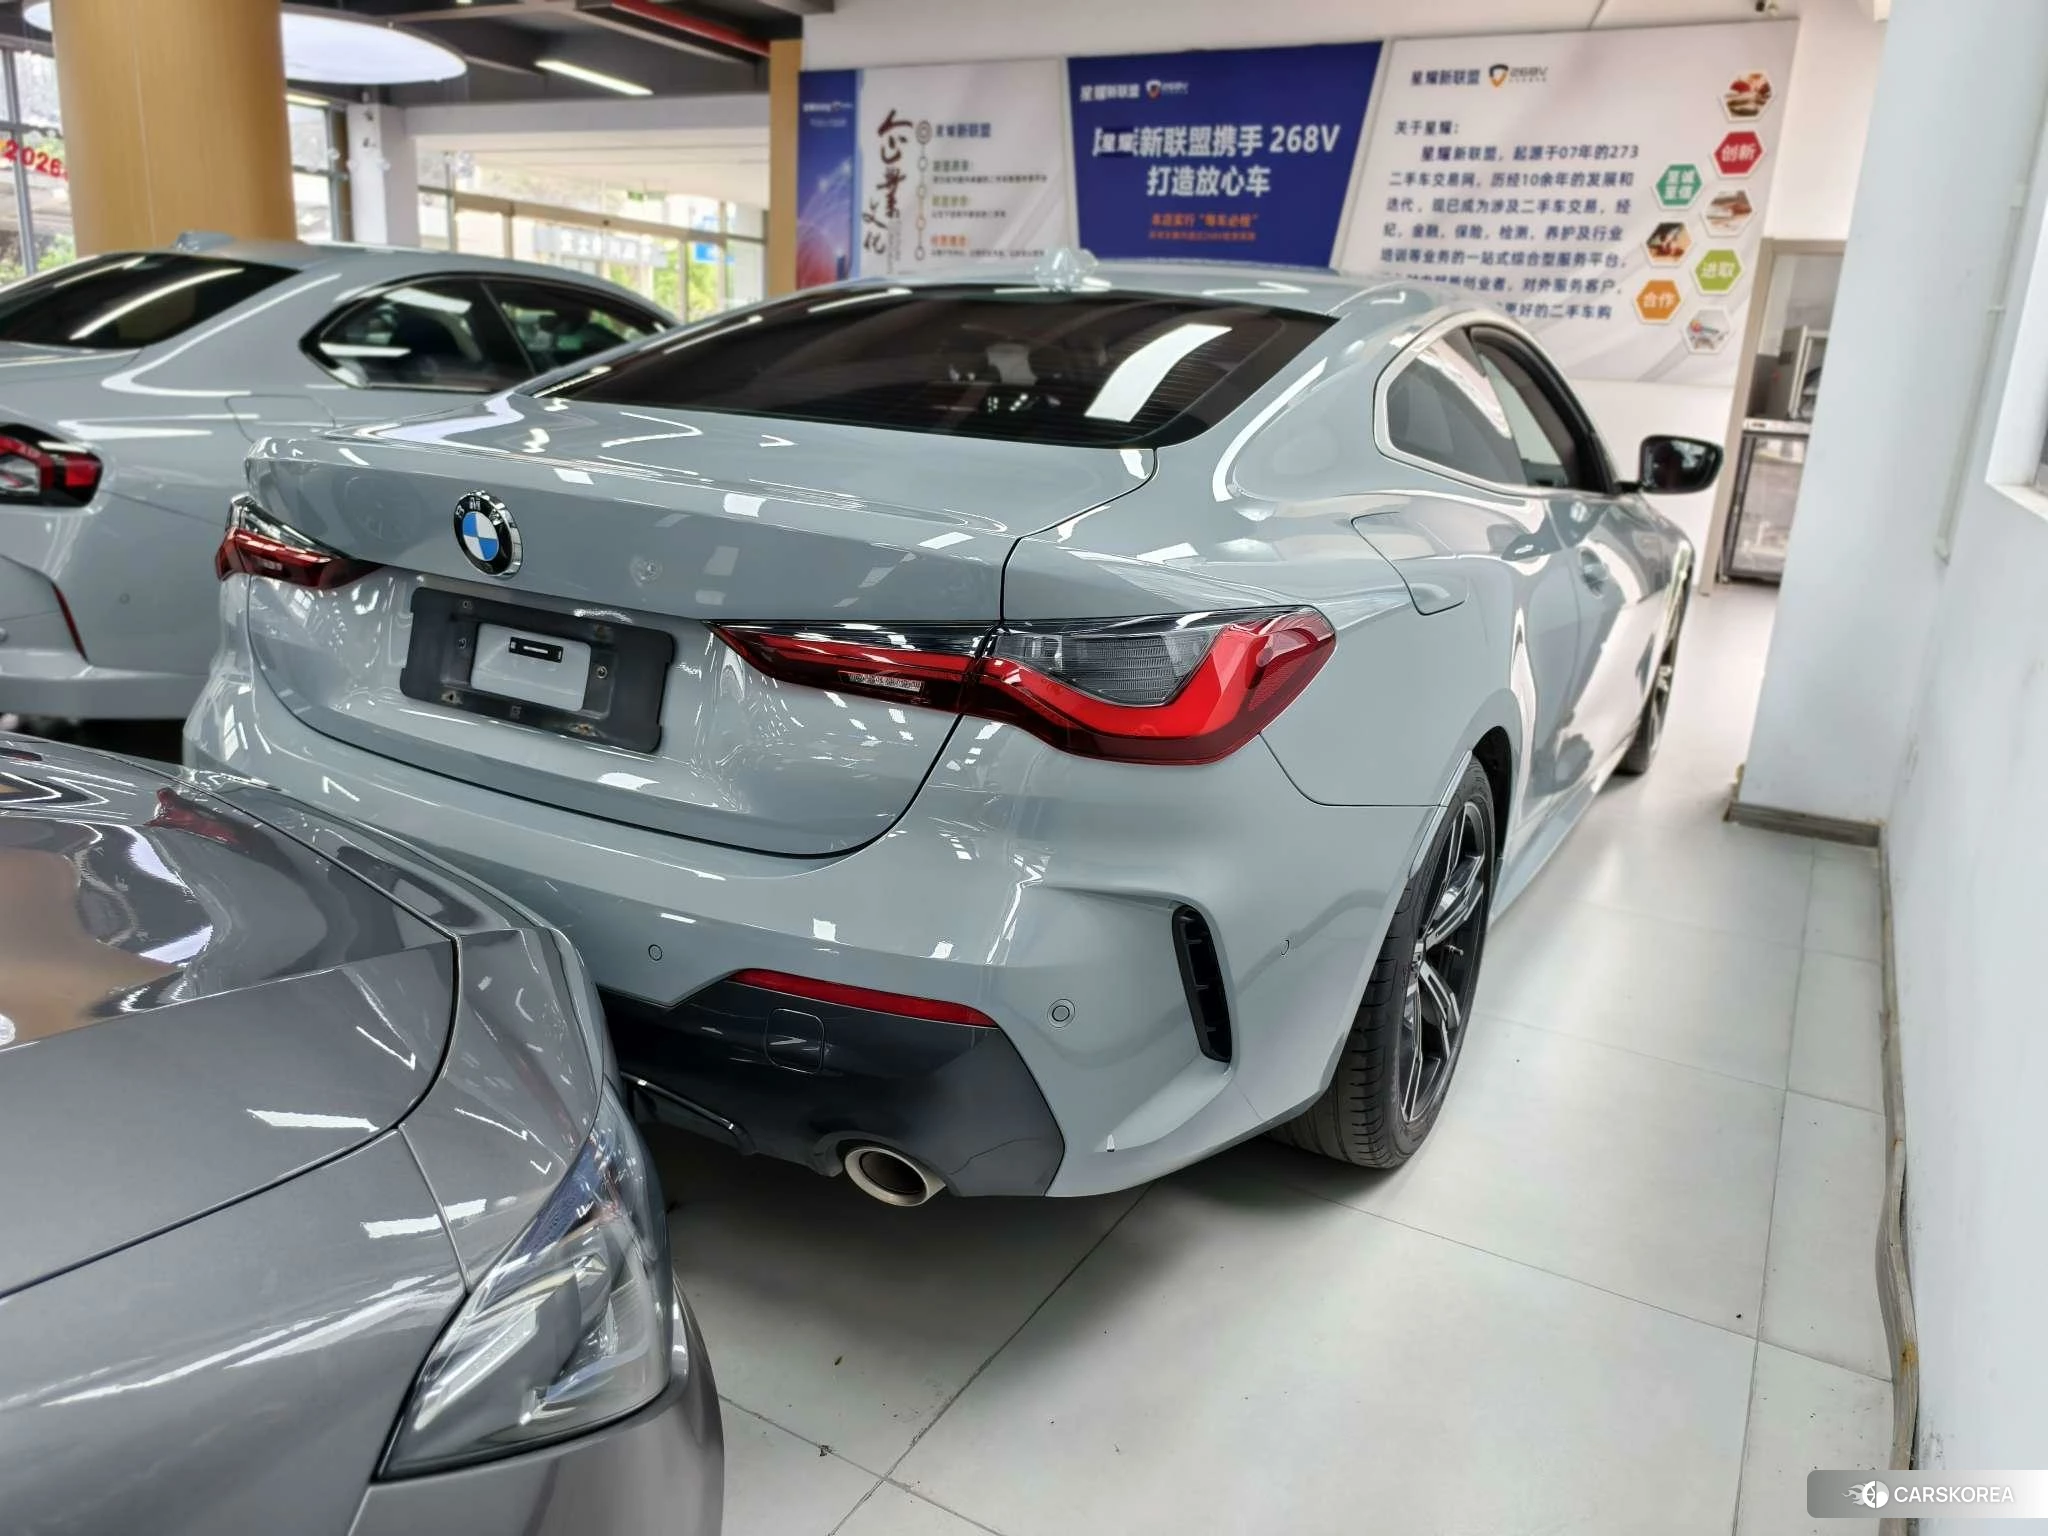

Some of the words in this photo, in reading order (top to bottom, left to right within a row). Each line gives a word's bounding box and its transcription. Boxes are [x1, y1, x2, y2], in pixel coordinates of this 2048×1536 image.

[1411, 69, 1480, 86] 星耀新联盟
[1269, 125, 1341, 152] 268V
[1721, 144, 1755, 162] 创新
[1147, 165, 1272, 197] 打造放心车
[1643, 291, 1677, 309] 合作
[1497, 302, 1612, 320] 更好的二手车购
